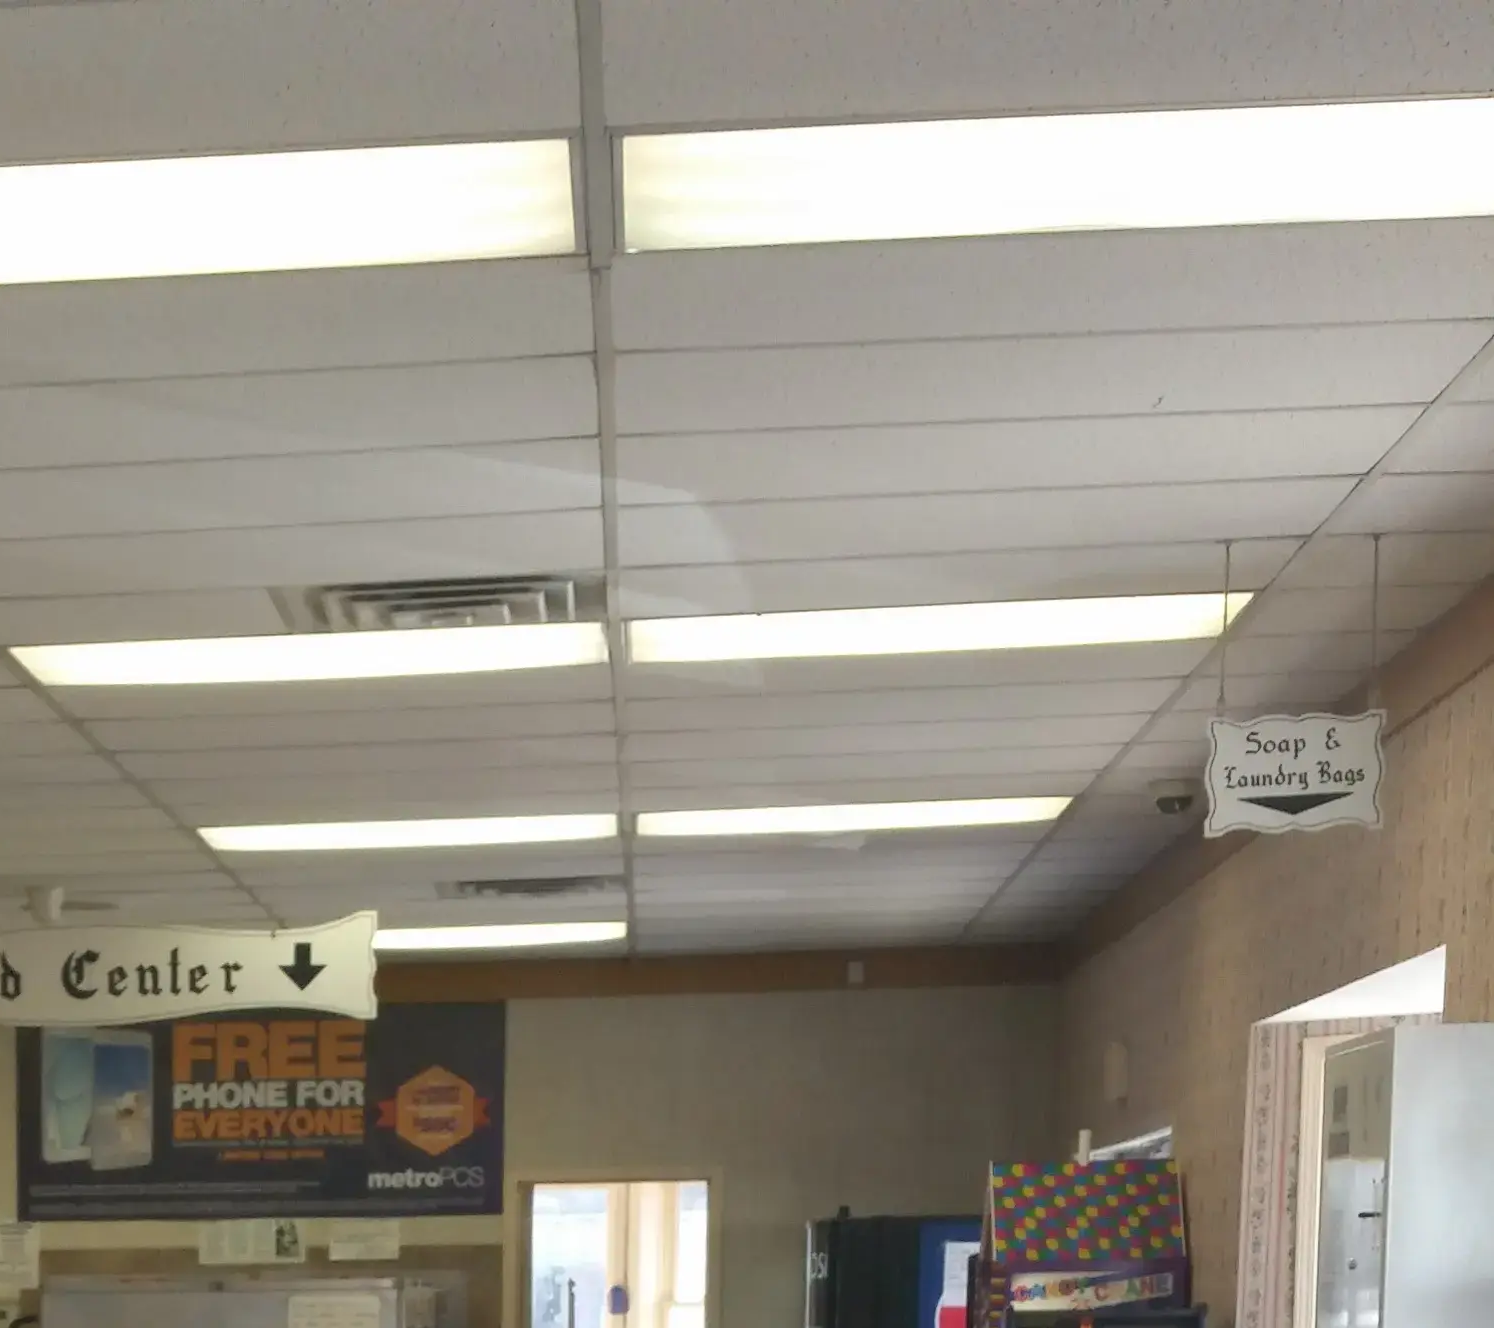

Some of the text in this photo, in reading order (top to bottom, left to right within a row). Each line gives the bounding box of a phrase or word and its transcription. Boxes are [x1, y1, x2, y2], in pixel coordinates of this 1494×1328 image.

[1246, 727, 1341, 760] Soap &
[1224, 760, 1365, 790] Laundry Bags
[62, 947, 244, 1000] Center
[173, 1020, 366, 1081] FREE
[173, 1080, 365, 1110] PHONE FOR
[173, 1107, 365, 1140] EVERYONE
[368, 1166, 485, 1189] metroPCS
